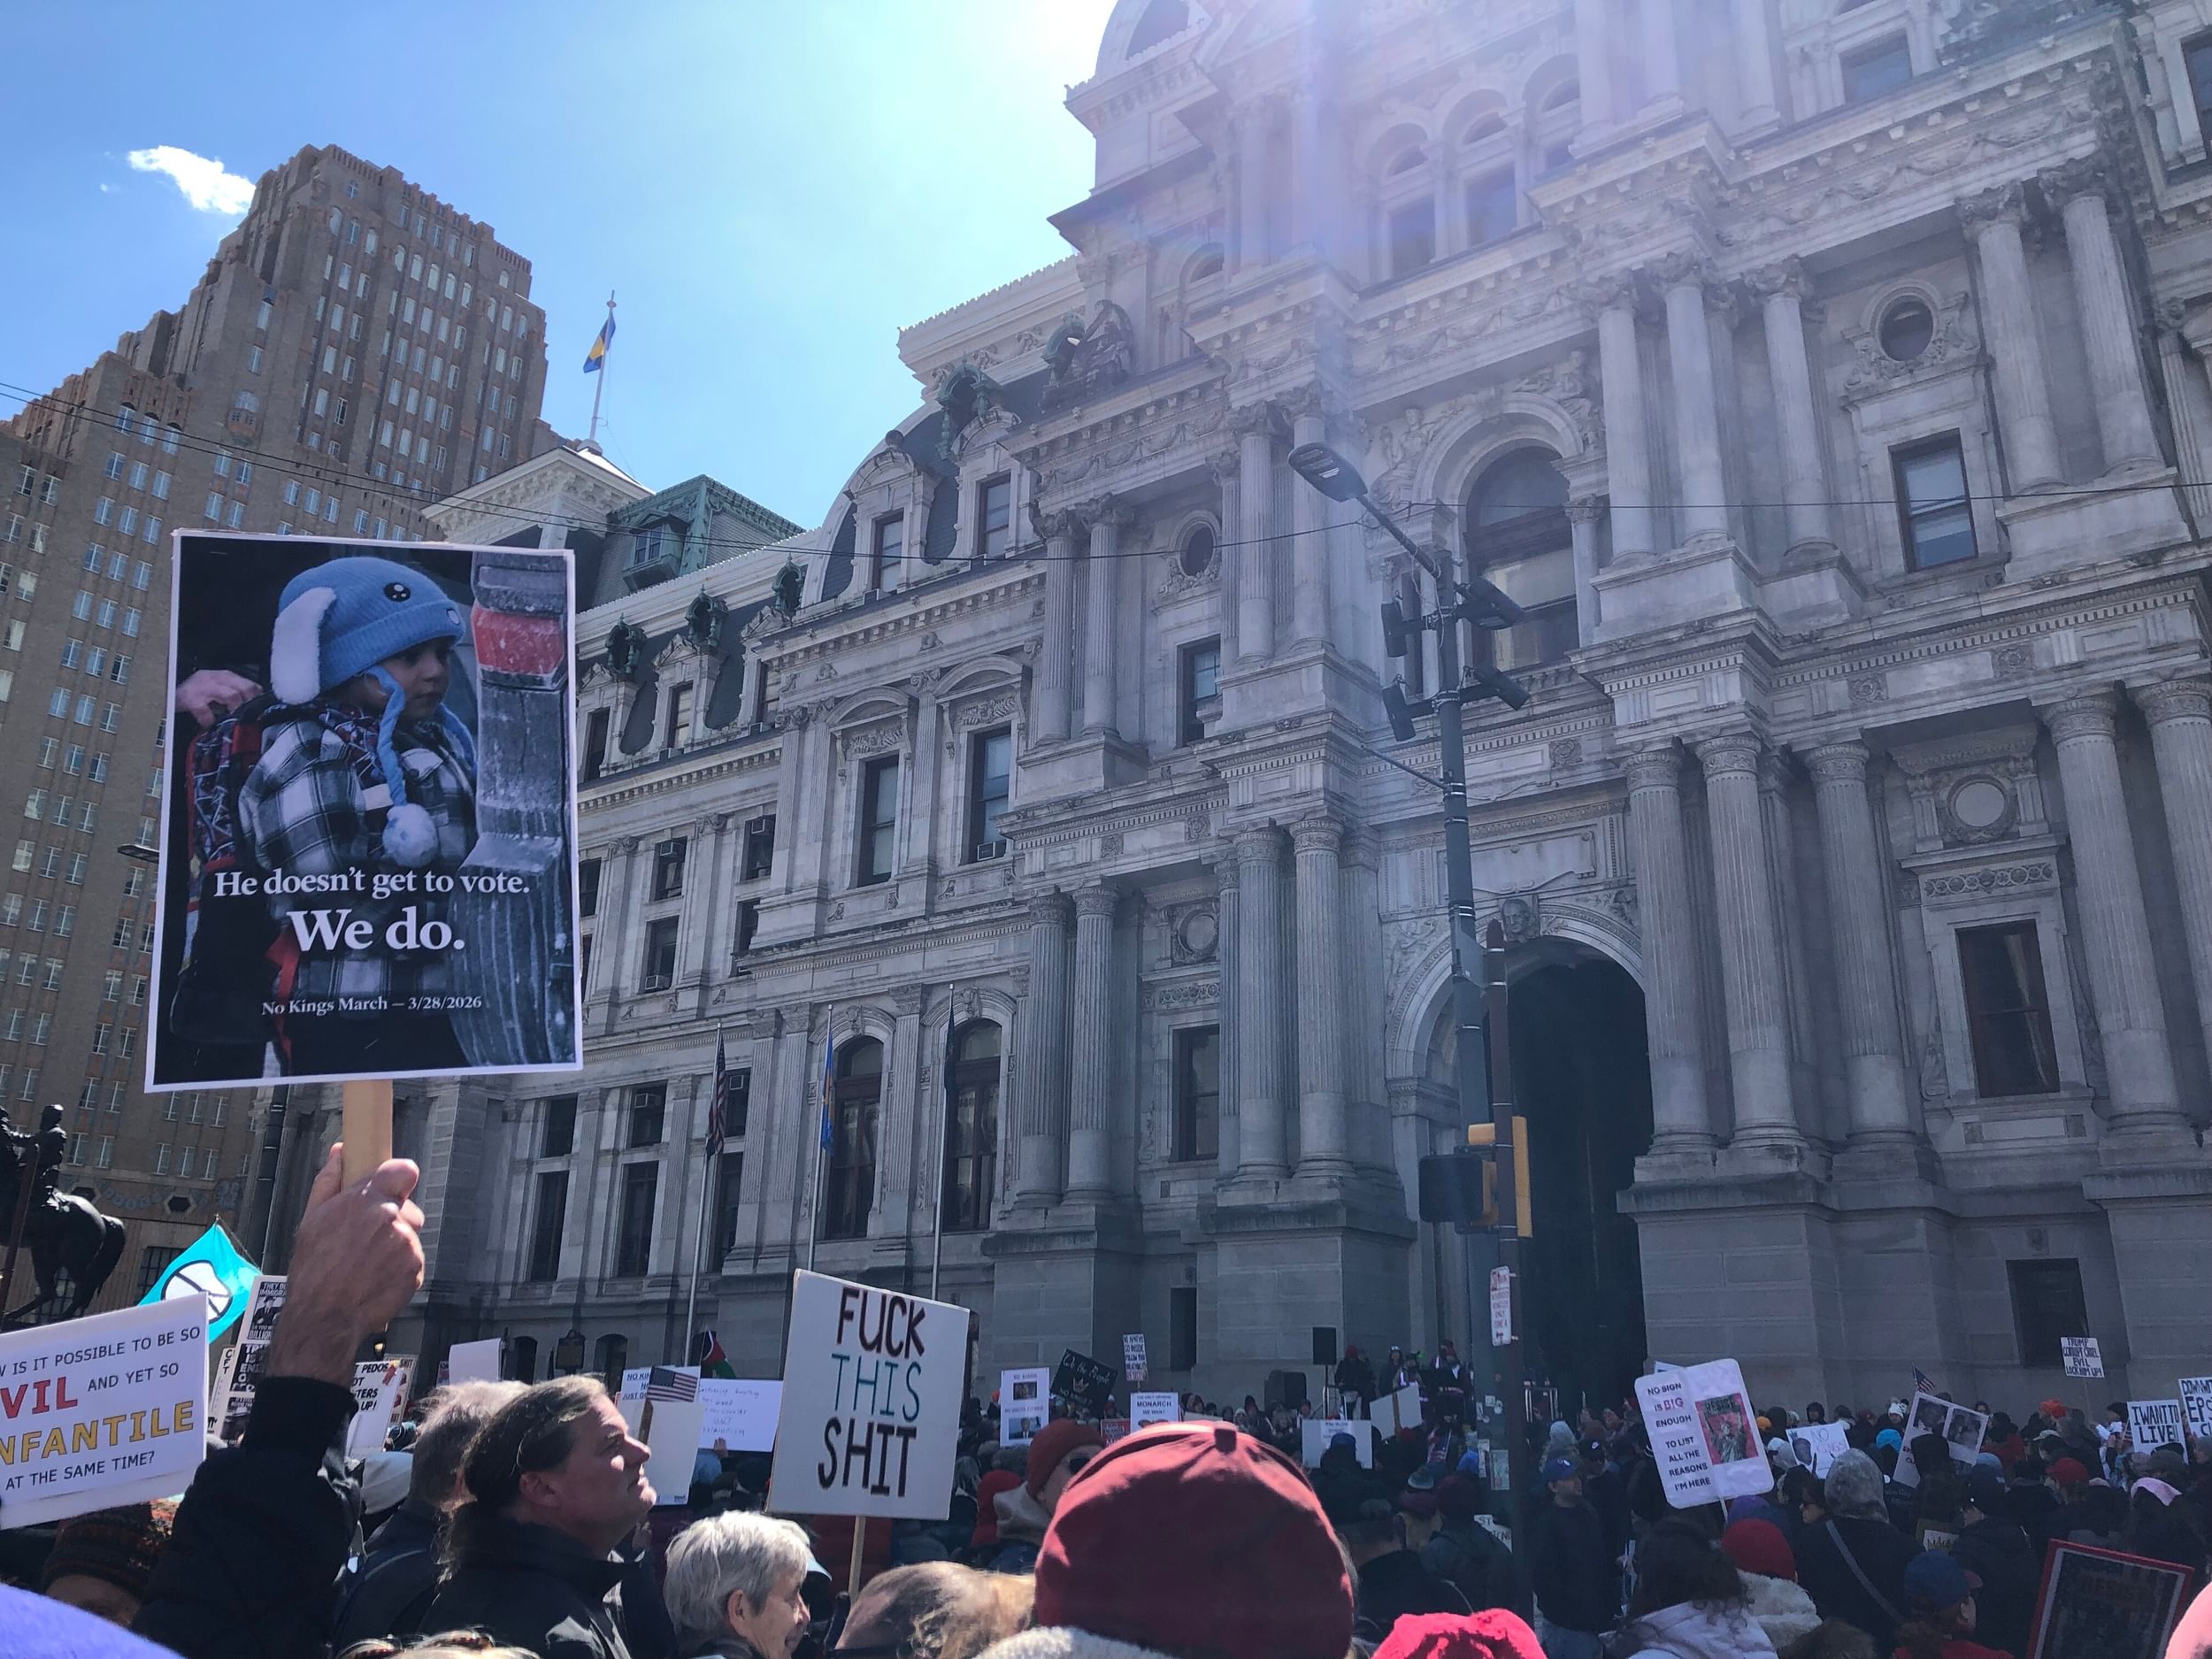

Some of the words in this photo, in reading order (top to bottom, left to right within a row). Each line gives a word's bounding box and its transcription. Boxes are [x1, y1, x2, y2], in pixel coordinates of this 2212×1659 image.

[213, 872, 257, 896] He
[264, 866, 365, 895] doesn't
[372, 872, 417, 899] get
[426, 871, 454, 893] to
[460, 872, 530, 893] vote.
[287, 909, 373, 952] We
[385, 906, 465, 950] do.
[262, 1002, 285, 1015] No
[289, 999, 334, 1016] Kings
[339, 996, 388, 1010] March
[408, 996, 481, 1010] 3/28/2026
[836, 1286, 926, 1359] FUCK
[2067, 1338, 2088, 1347] TRUMP
[12, 1362, 27, 1375] IS
[33, 1357, 49, 1371] IT
[55, 1342, 125, 1366] POSSIBLE
[132, 1337, 150, 1351] TO
[157, 1332, 173, 1347] BE
[180, 1326, 200, 1341] SO
[2073, 1357, 2090, 1366] EVIL
[2066, 1366, 2080, 1375] LOCK
[2080, 1367, 2090, 1376] HIM
[2090, 1368, 2102, 1377] UP!
[353, 1377, 365, 1386] OT
[831, 1353, 922, 1422] THIS
[1662, 1383, 1682, 1393] SIGN
[0, 1376, 78, 1419] VIL
[88, 1375, 119, 1392] AND
[126, 1368, 154, 1384] YET
[159, 1363, 179, 1378] SO
[361, 1402, 377, 1410] UP!
[1663, 1397, 1684, 1411] BIG
[1655, 1415, 1692, 1427] ENOUGH
[2131, 1406, 2140, 1425] I
[2139, 1405, 2167, 1425] WANT
[2168, 1405, 2179, 1424] TO
[0, 1401, 194, 1465] NFANTILE
[1811, 1428, 1829, 1442] NO
[1678, 1437, 1694, 1447] LIST
[818, 1417, 917, 1497] SHIT
[1669, 1454, 1684, 1463] ALL
[1685, 1450, 1700, 1459] THE
[5, 1476, 23, 1490] AT
[29, 1470, 57, 1486] THE
[64, 1461, 105, 1479] SAME
[111, 1451, 155, 1471] TIME?
[1670, 1463, 1708, 1477] REASONS
[1674, 1482, 1688, 1492] I'M
[1688, 1478, 1710, 1489] HERE
